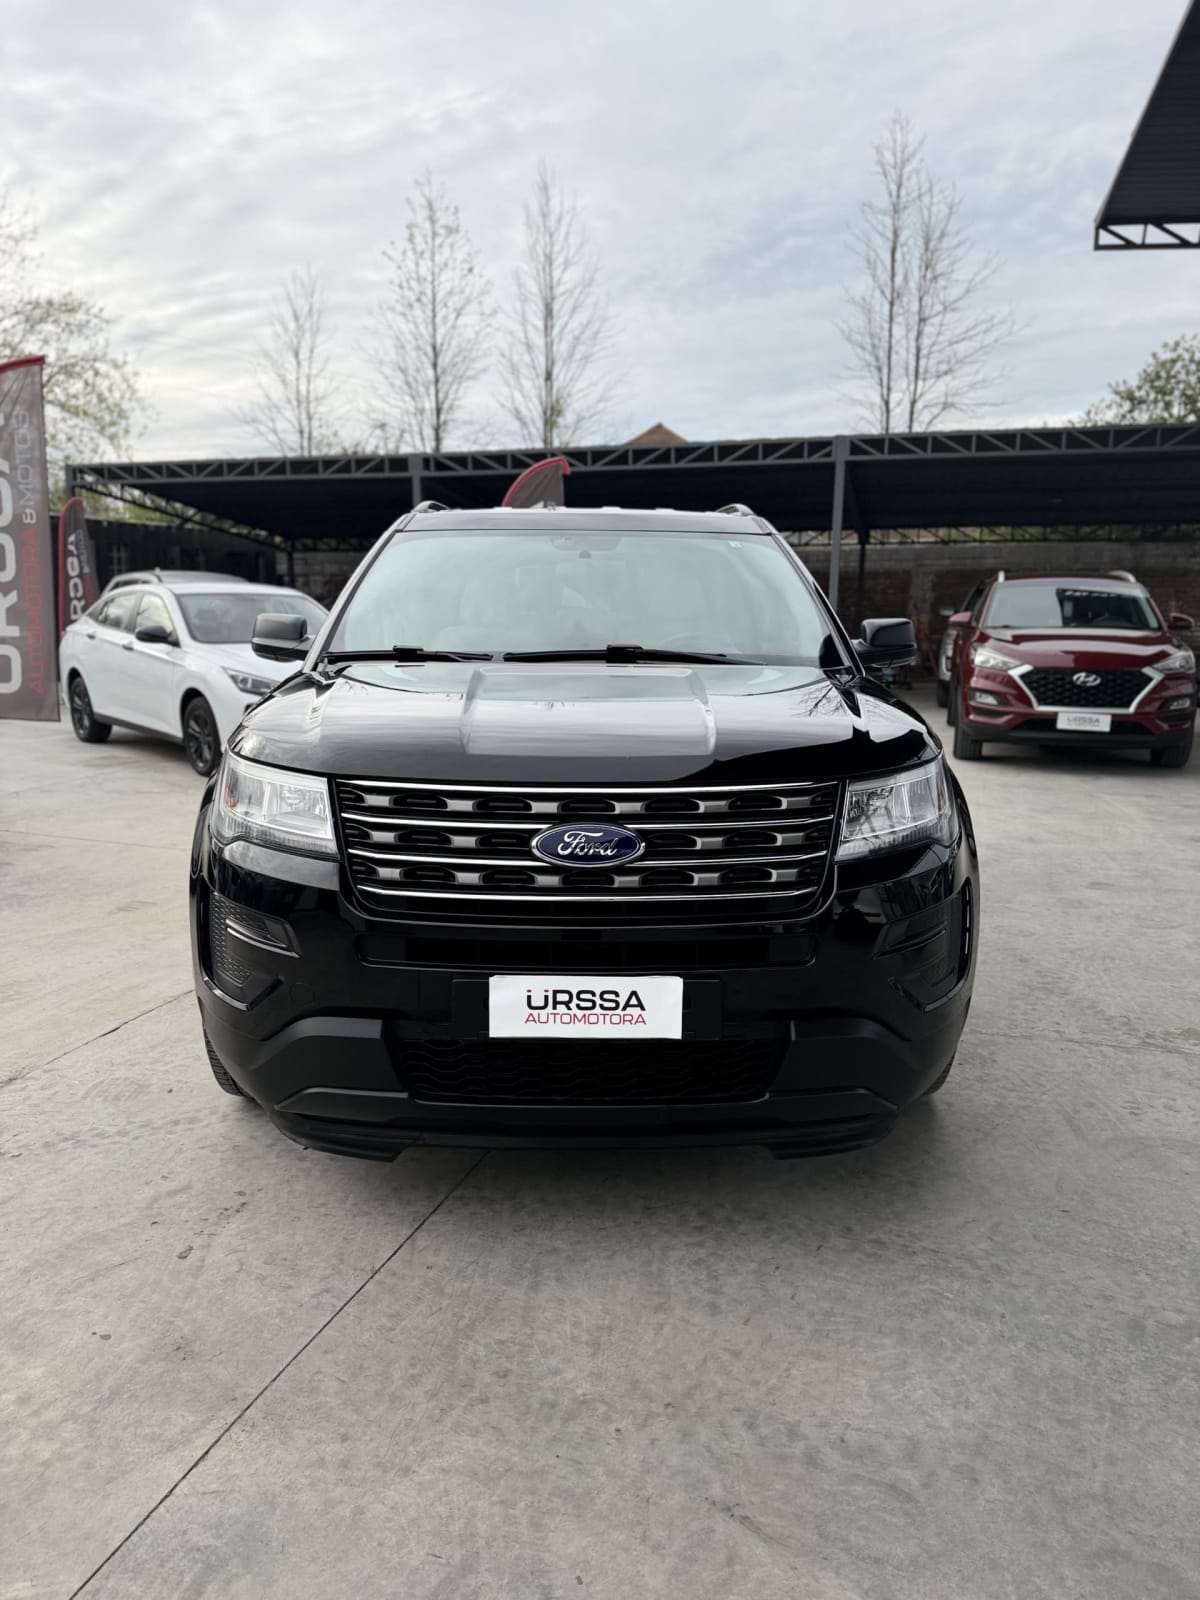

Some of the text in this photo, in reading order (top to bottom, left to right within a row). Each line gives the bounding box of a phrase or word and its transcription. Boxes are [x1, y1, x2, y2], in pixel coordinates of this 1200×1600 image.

[12, 406, 34, 505] MOTOS
[22, 527, 45, 694] AUTOMOTORA
[557, 831, 619, 856] Ford
[524, 1012, 647, 1025] AUTOMOTORA
